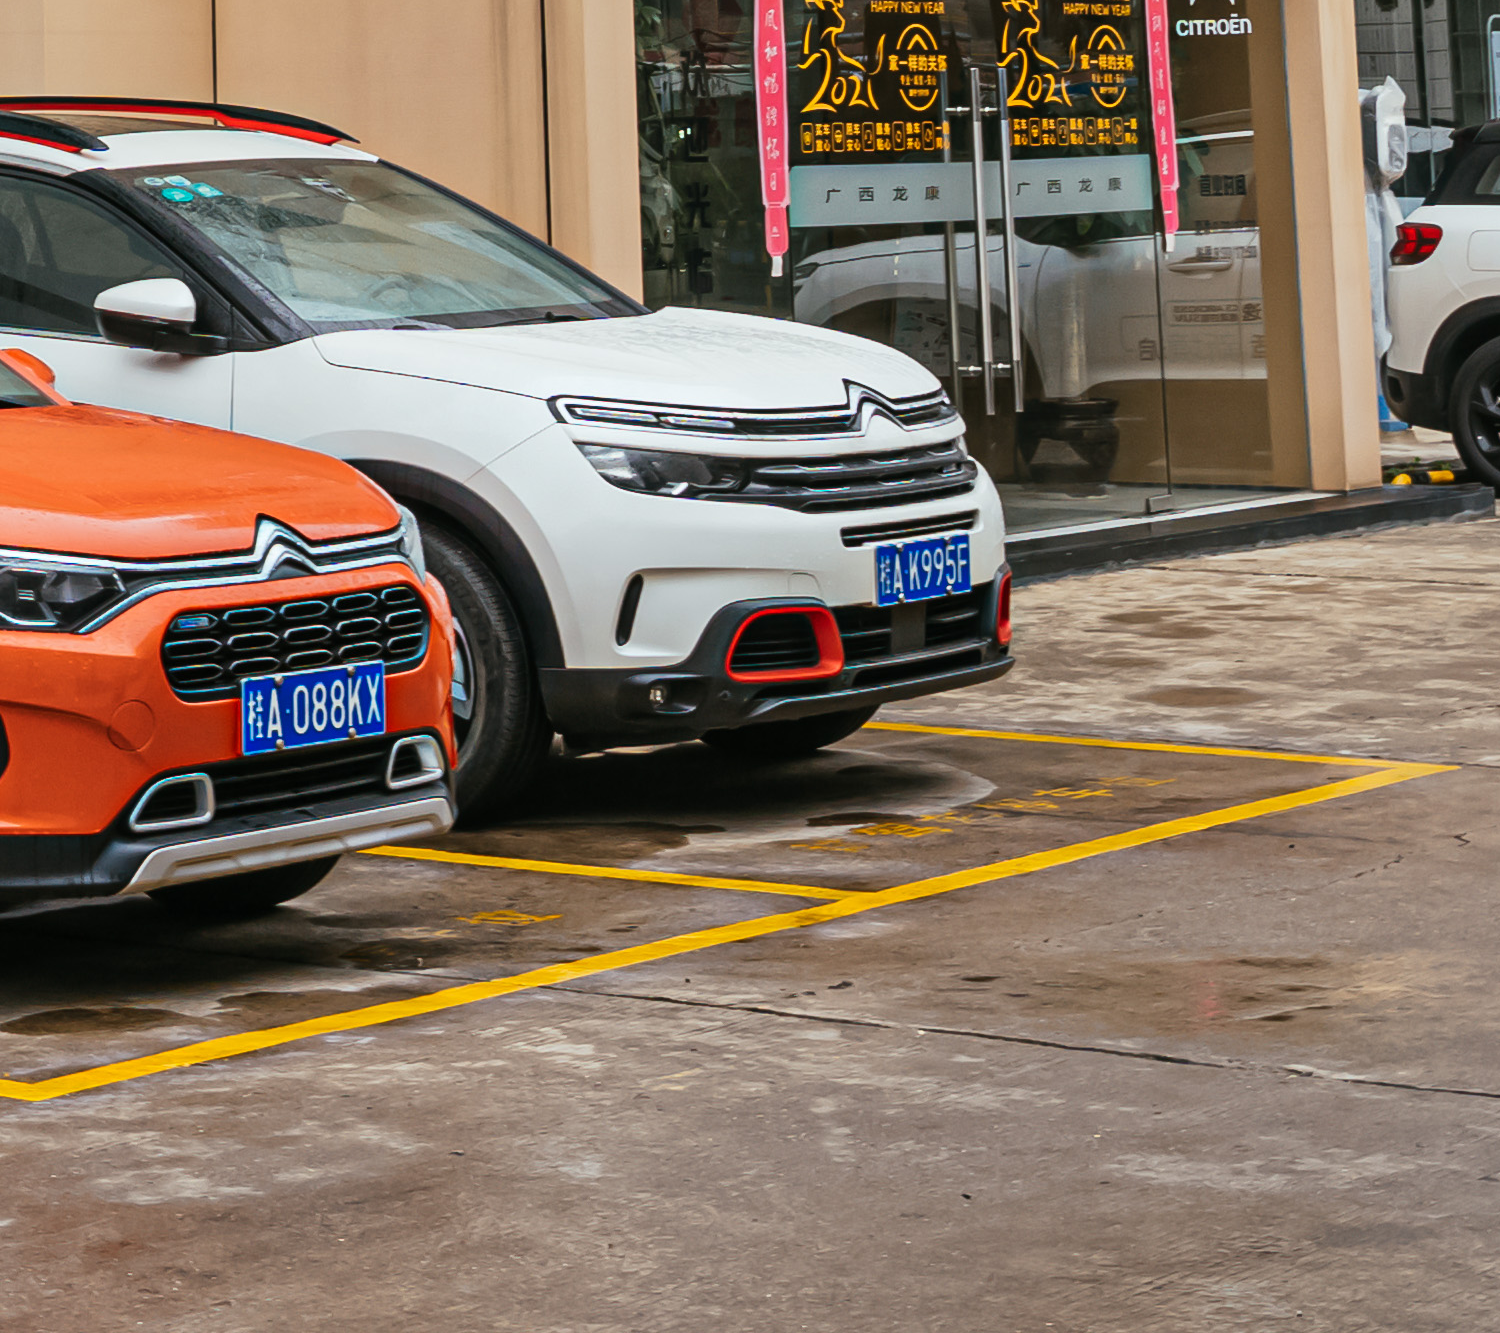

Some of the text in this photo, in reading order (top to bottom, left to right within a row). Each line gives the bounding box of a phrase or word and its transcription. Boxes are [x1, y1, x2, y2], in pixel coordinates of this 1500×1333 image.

[870, 1, 945, 14] HAPPY NEW YEAR
[1063, 3, 1131, 16] HAPPY NEW YEAR
[825, 185, 941, 203] 广西龙康
[1016, 177, 1123, 196] 广西龙康
